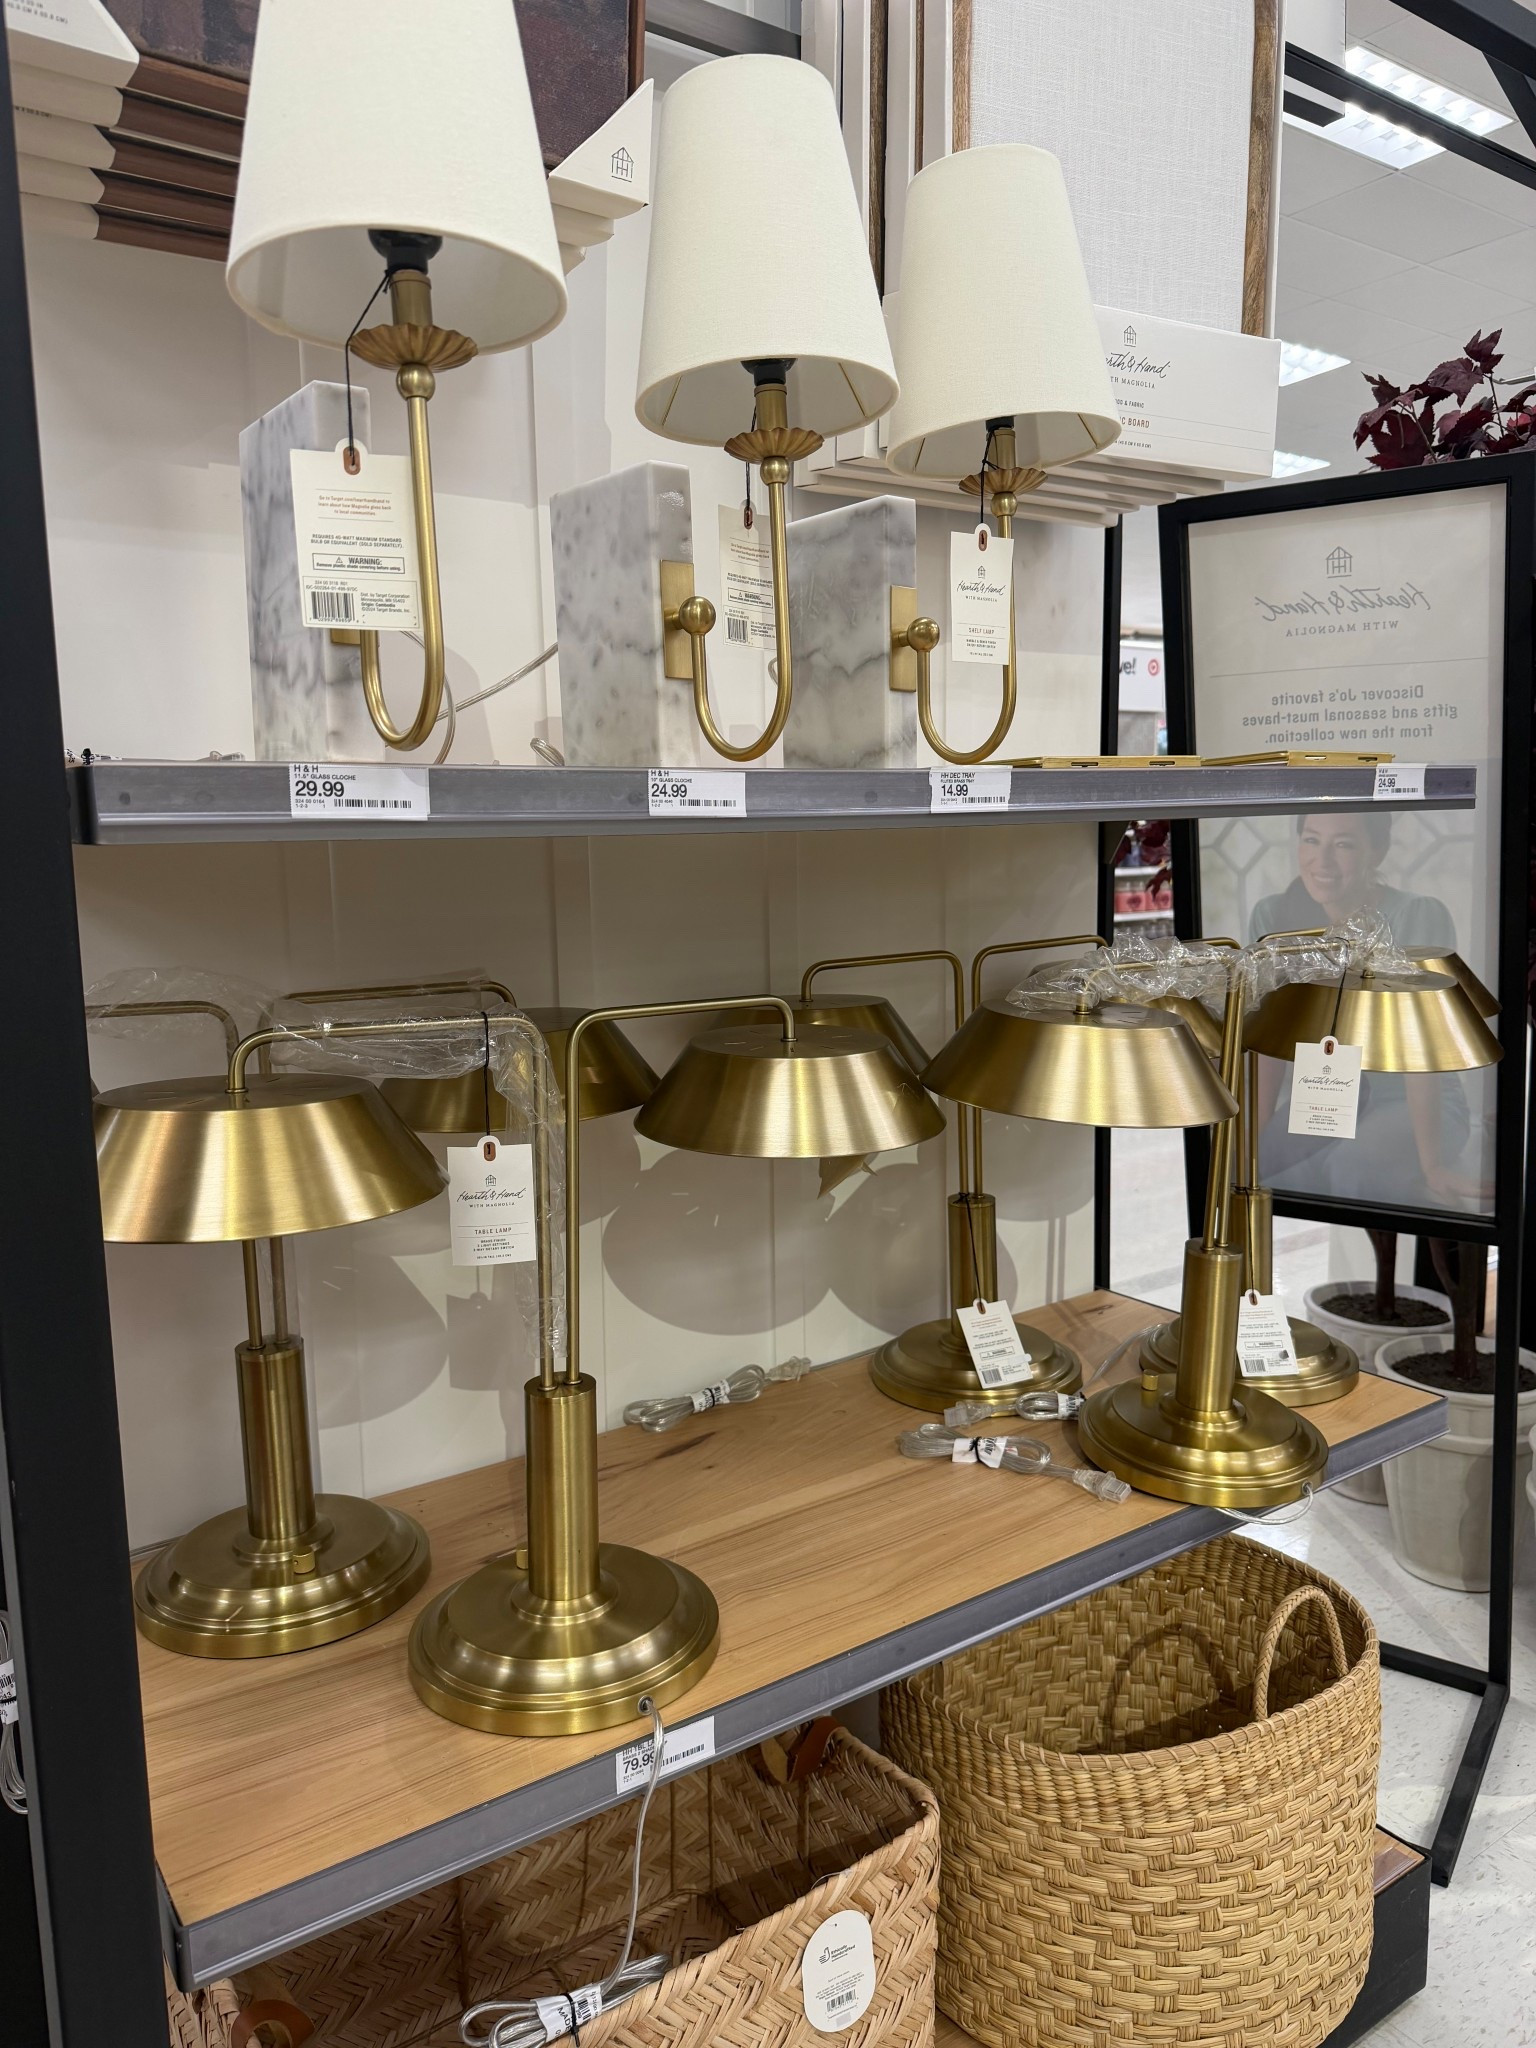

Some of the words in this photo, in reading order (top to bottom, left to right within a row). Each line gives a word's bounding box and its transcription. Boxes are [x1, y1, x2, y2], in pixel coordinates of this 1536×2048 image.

[1106, 352, 1130, 370] rth
[1134, 357, 1170, 378] Hand
[1122, 378, 1155, 389] MAGNOLIA
[1128, 418, 1150, 428] BOARD
[348, 557, 382, 565] WARNING:
[984, 583, 1006, 596] Hand
[1119, 657, 1136, 674] ve!
[295, 780, 344, 797] 29.99
[1379, 778, 1395, 788] 24.99
[652, 783, 687, 798] 24.99
[941, 784, 968, 796] 14.99
[1329, 1078, 1354, 1087] Hand
[457, 1188, 491, 1202] Hearth
[490, 1190, 496, 1200] &
[496, 1188, 526, 1200] Hand
